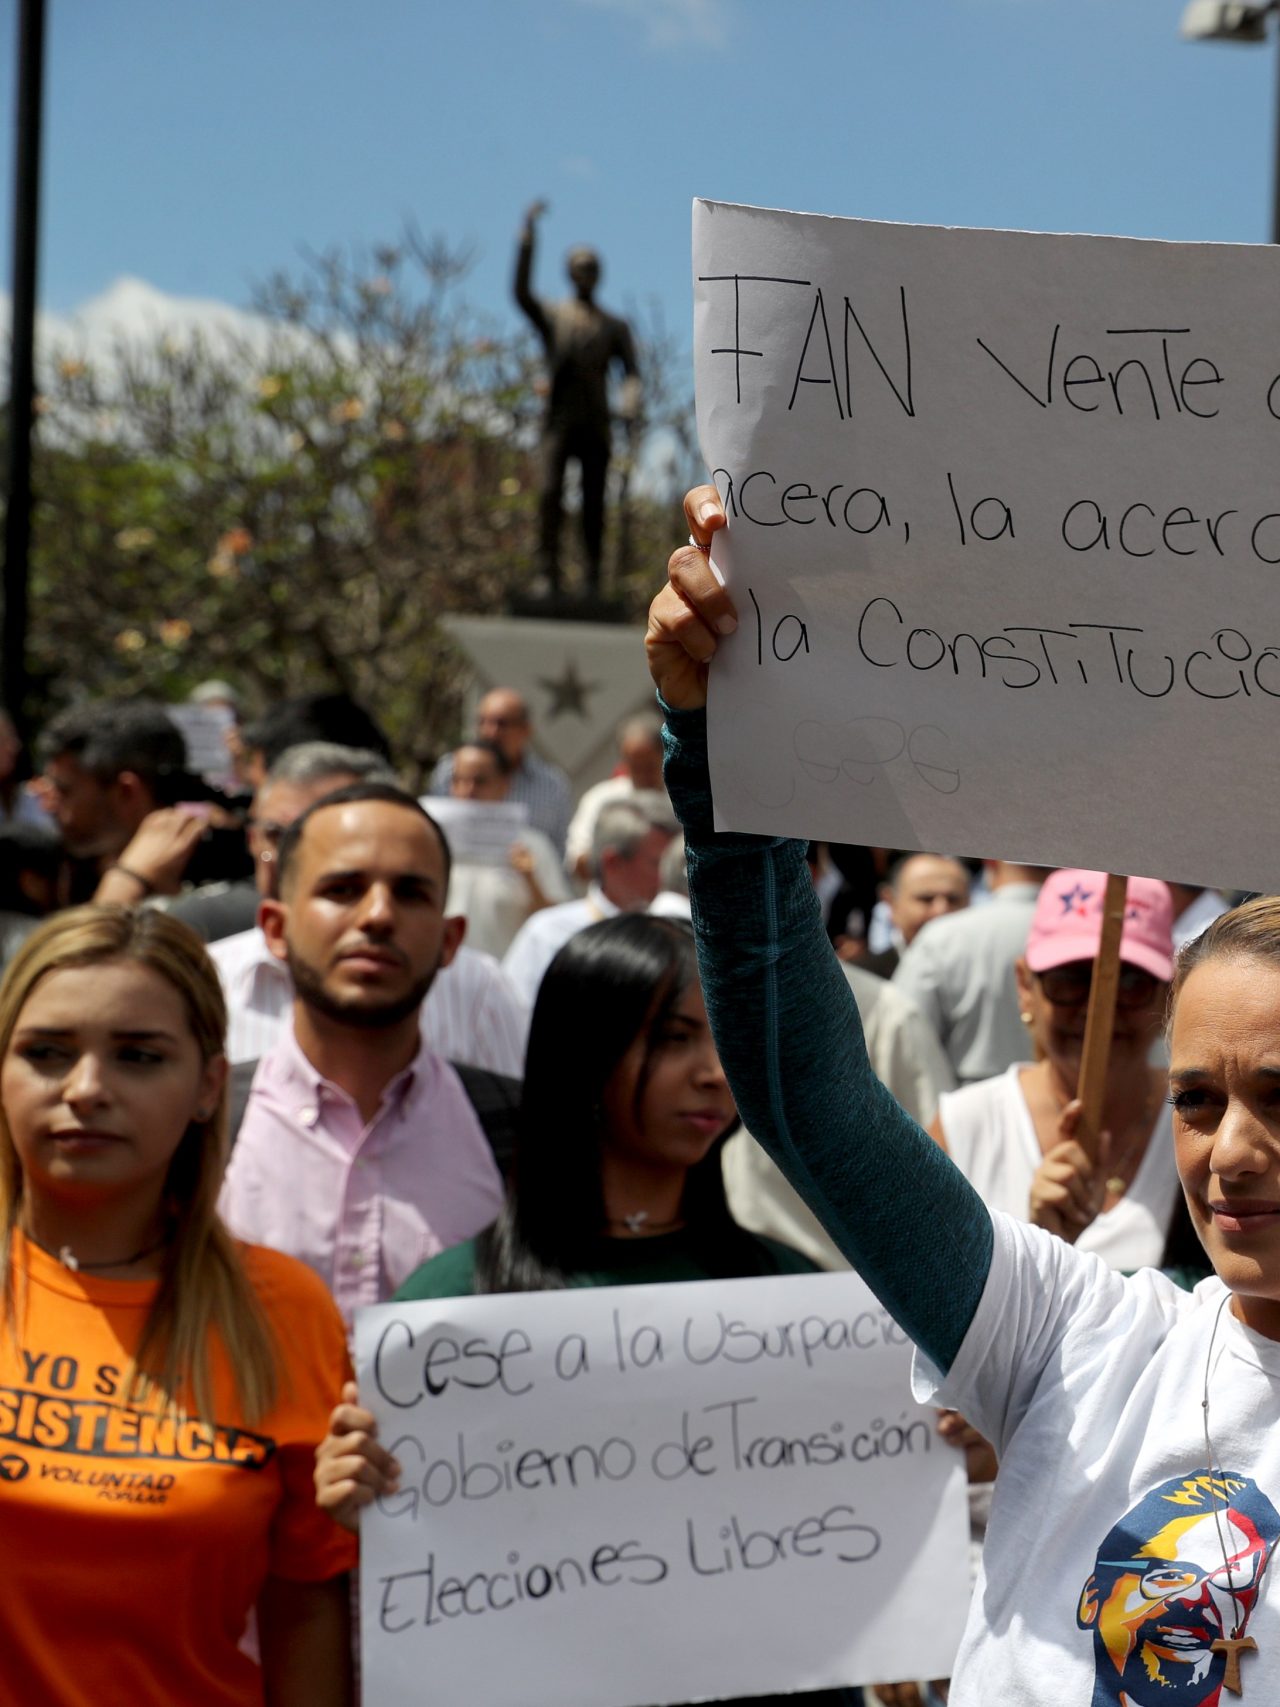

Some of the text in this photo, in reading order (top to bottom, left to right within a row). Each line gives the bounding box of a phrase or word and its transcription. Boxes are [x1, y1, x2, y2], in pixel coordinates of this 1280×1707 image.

[699, 274, 914, 420] FAN
[947, 473, 1014, 545] la
[749, 588, 809, 665] la
[22, 1350, 79, 1391] YO
[375, 1319, 534, 1407] Cese
[555, 1334, 589, 1380] a
[613, 1309, 664, 1372] la
[40, 1463, 176, 1491] VOLUNTAD
[376, 1433, 636, 1522] Gobierno
[379, 1505, 882, 1634] Elecciones Libres
